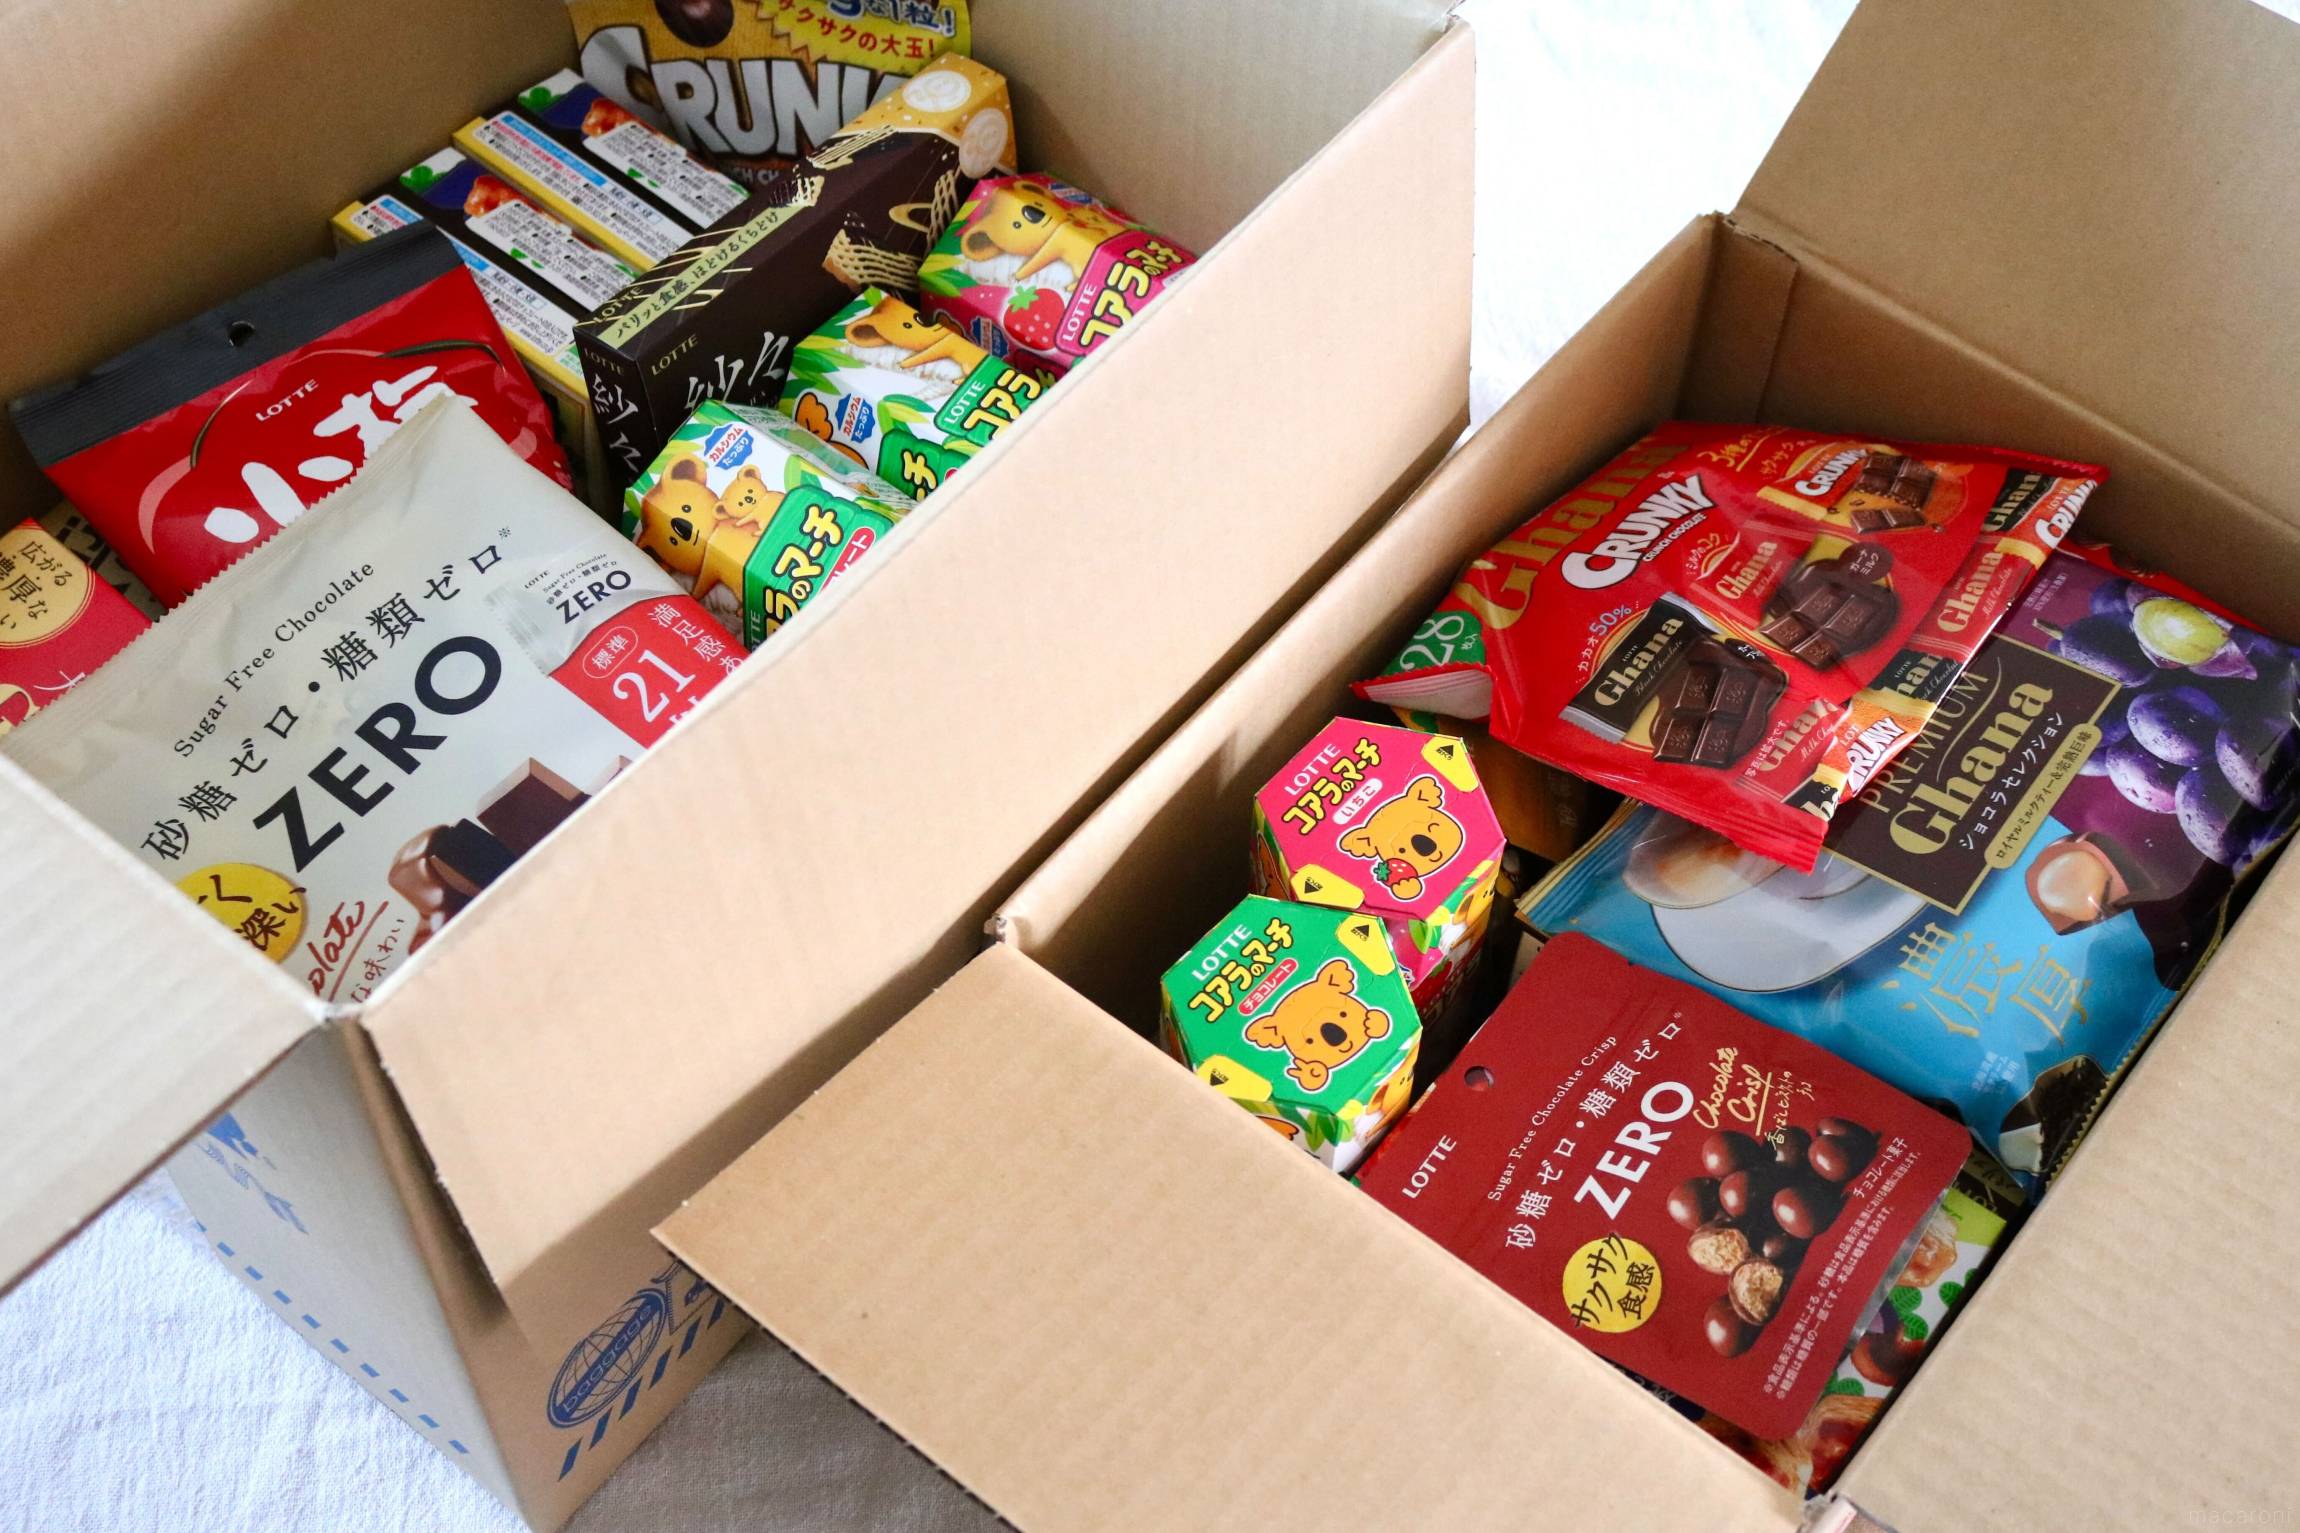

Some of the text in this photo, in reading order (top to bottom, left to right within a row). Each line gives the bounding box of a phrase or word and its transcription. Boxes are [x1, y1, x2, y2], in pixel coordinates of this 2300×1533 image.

[595, 286, 644, 323] LOTTE
[1062, 283, 1097, 342] LOTTE
[583, 347, 624, 376] LOTTE
[651, 334, 699, 377] LOTTE
[255, 378, 320, 422] LOTTE
[943, 380, 985, 424] LOTTE
[709, 425, 743, 463] カルシウム
[722, 437, 749, 467] たっぷり
[1561, 474, 1716, 590] CRUNKY
[20, 541, 72, 586] 広がる
[524, 569, 550, 589] LOTTE
[1716, 541, 1778, 600] Ghana
[1937, 551, 2003, 632] Ghana
[556, 570, 631, 624] ZERO
[174, 561, 374, 757] Sugar Free Chocolate
[591, 633, 629, 670] 標準
[1400, 615, 1464, 670] 28
[1594, 618, 1684, 706] Ghana
[612, 649, 696, 723] 21
[252, 636, 502, 873] ZERO
[1284, 743, 1341, 796] LOTTE
[1858, 671, 1989, 814] PREMIUM
[1890, 682, 2053, 855] Ghana
[1282, 737, 1382, 836] コアラのマーチ
[1959, 712, 2063, 850] ショコラセレクション
[1188, 917, 1294, 1023] コアラのマーチ
[1191, 923, 1253, 982] LOTTE
[1242, 962, 1294, 1011] チョコレート
[1693, 1047, 1738, 1129] Chocolate
[1727, 1063, 1775, 1123] Crisp
[1488, 1035, 1617, 1201] Sugar Free Chocolate Crisp
[1402, 1135, 1457, 1199] LOTTE
[1573, 1081, 1694, 1220] ZERO
[1853, 1136, 1908, 1199] チョコレート菓子
[1571, 1232, 1628, 1328] サクサク
[1617, 1261, 1655, 1320] 食感
